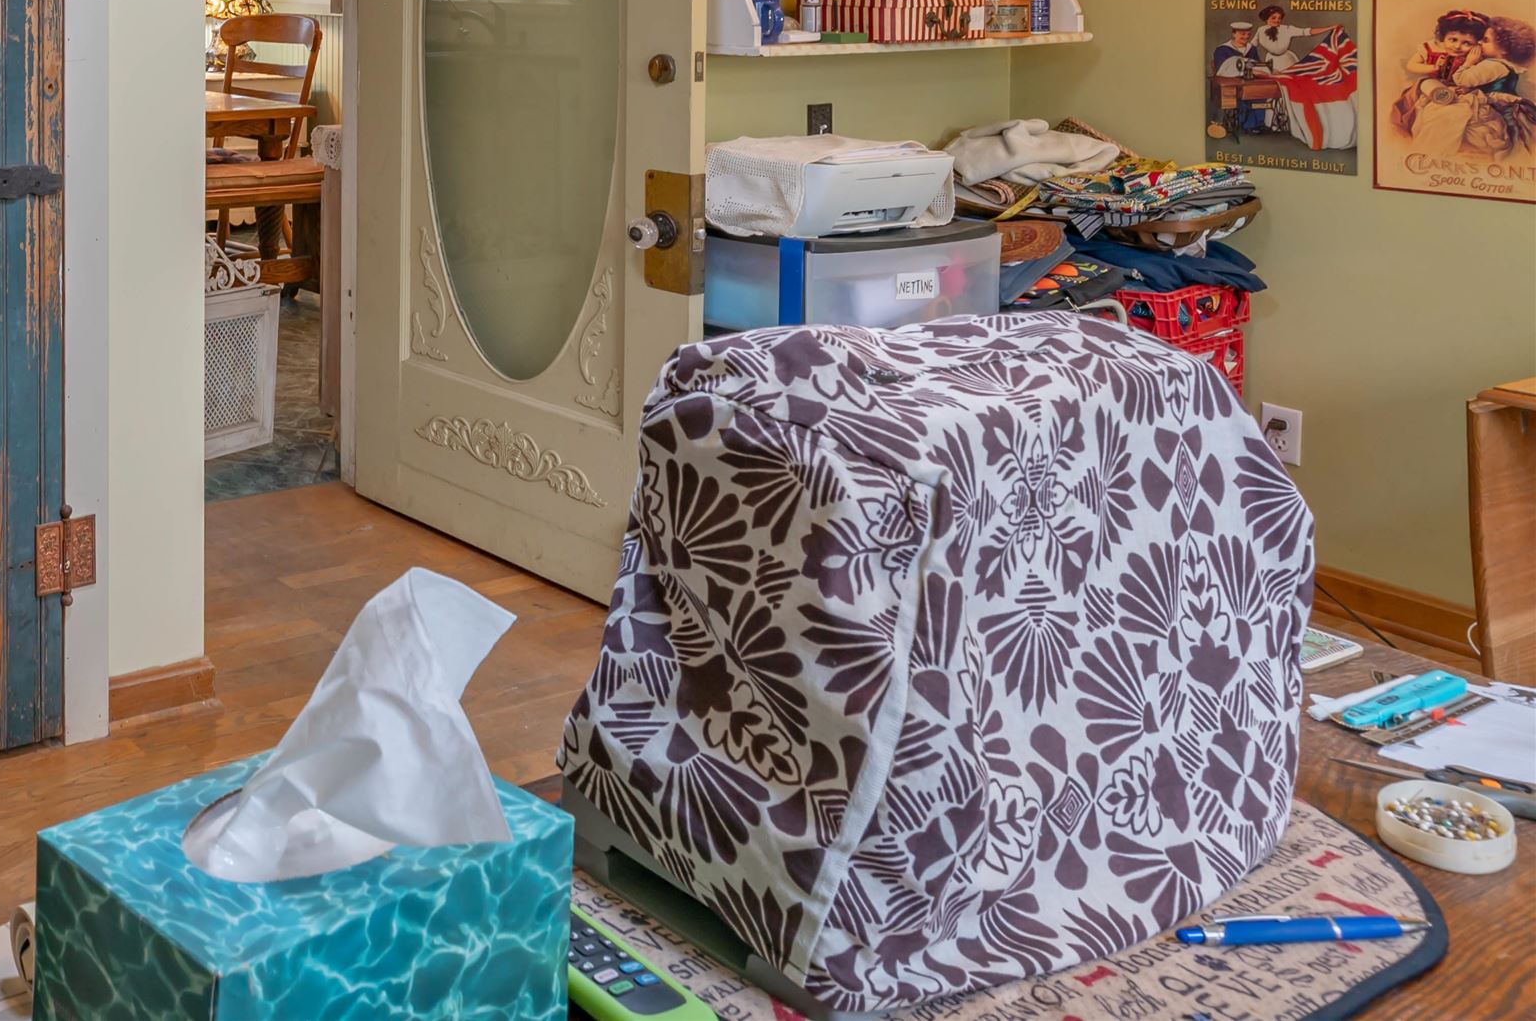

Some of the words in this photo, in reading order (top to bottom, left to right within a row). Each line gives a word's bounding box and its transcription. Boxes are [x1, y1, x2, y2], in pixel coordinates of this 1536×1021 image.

[1211, 0, 1257, 10] SEWING
[1290, 0, 1353, 11] MACHINES
[1247, 155, 1254, 164] &
[898, 279, 934, 295] NETTING
